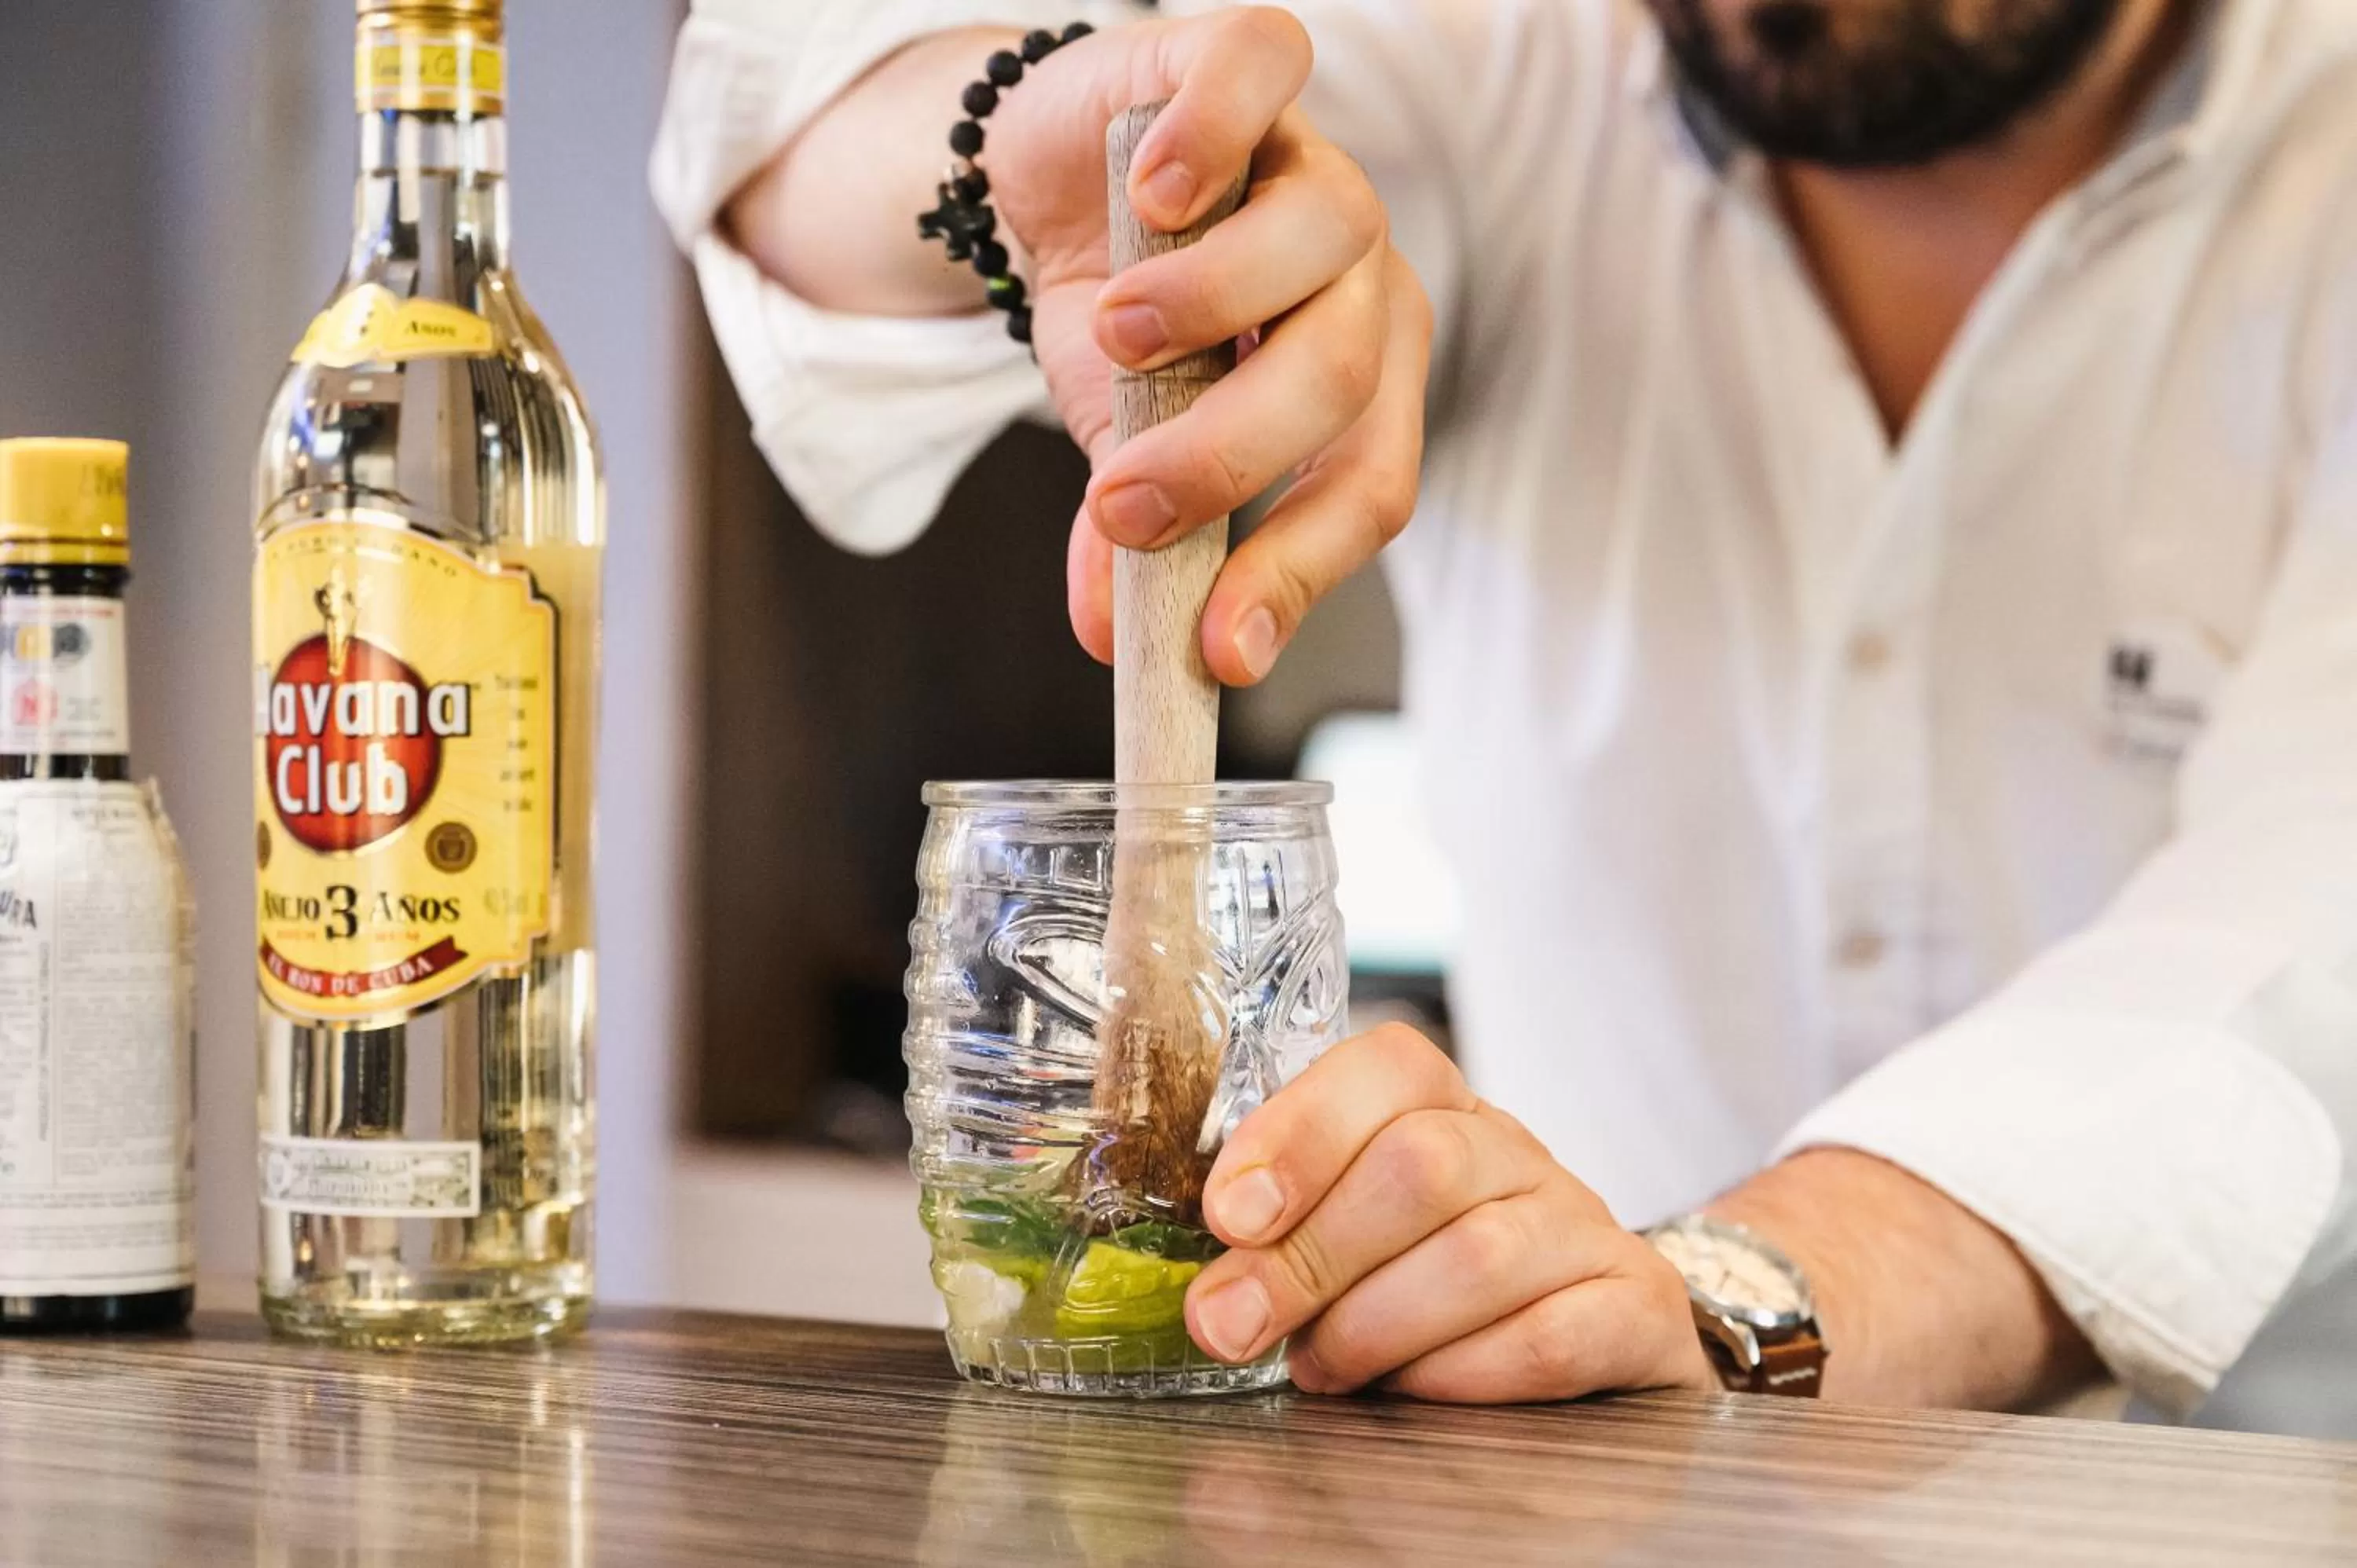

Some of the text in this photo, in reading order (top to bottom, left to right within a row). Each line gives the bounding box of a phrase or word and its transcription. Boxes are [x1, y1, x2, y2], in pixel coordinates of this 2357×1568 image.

[278, 742, 407, 815] Club
[324, 884, 358, 940] 3
[332, 976, 359, 995] DE
[368, 955, 434, 991] CUBA
